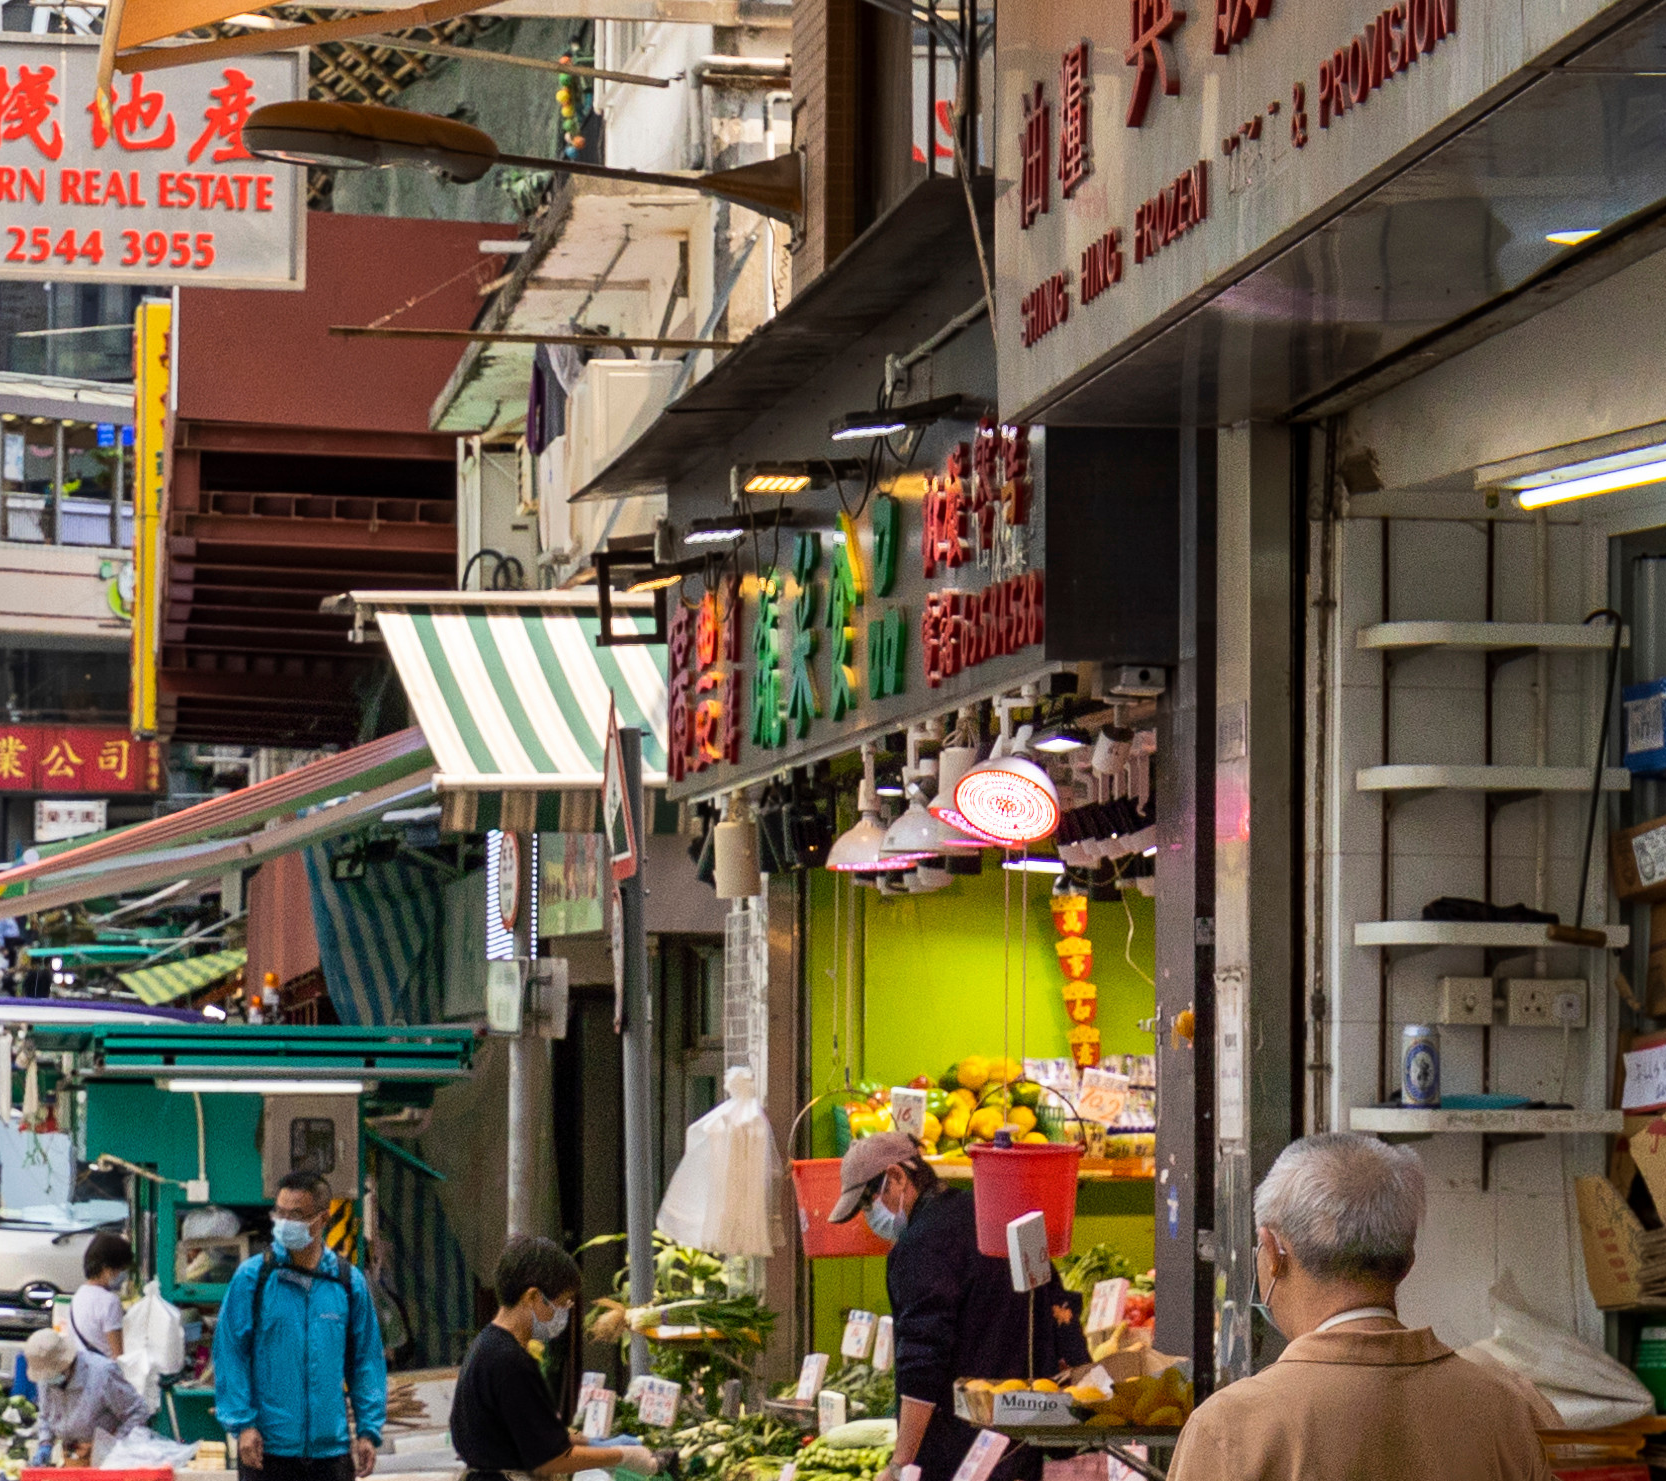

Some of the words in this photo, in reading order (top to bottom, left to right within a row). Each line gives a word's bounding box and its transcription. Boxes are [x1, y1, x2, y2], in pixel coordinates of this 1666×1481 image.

[1019, 41, 1090, 229] 糧油
[60, 168, 147, 207] REAL
[158, 172, 274, 212] ESTATE
[5, 226, 105, 263] 2544
[121, 229, 216, 268] 3955
[1020, 269, 1069, 350] SHING
[1081, 228, 1123, 307] HING
[1134, 161, 1207, 264] FROZEN
[1000, 1394, 1060, 1413] Mango
